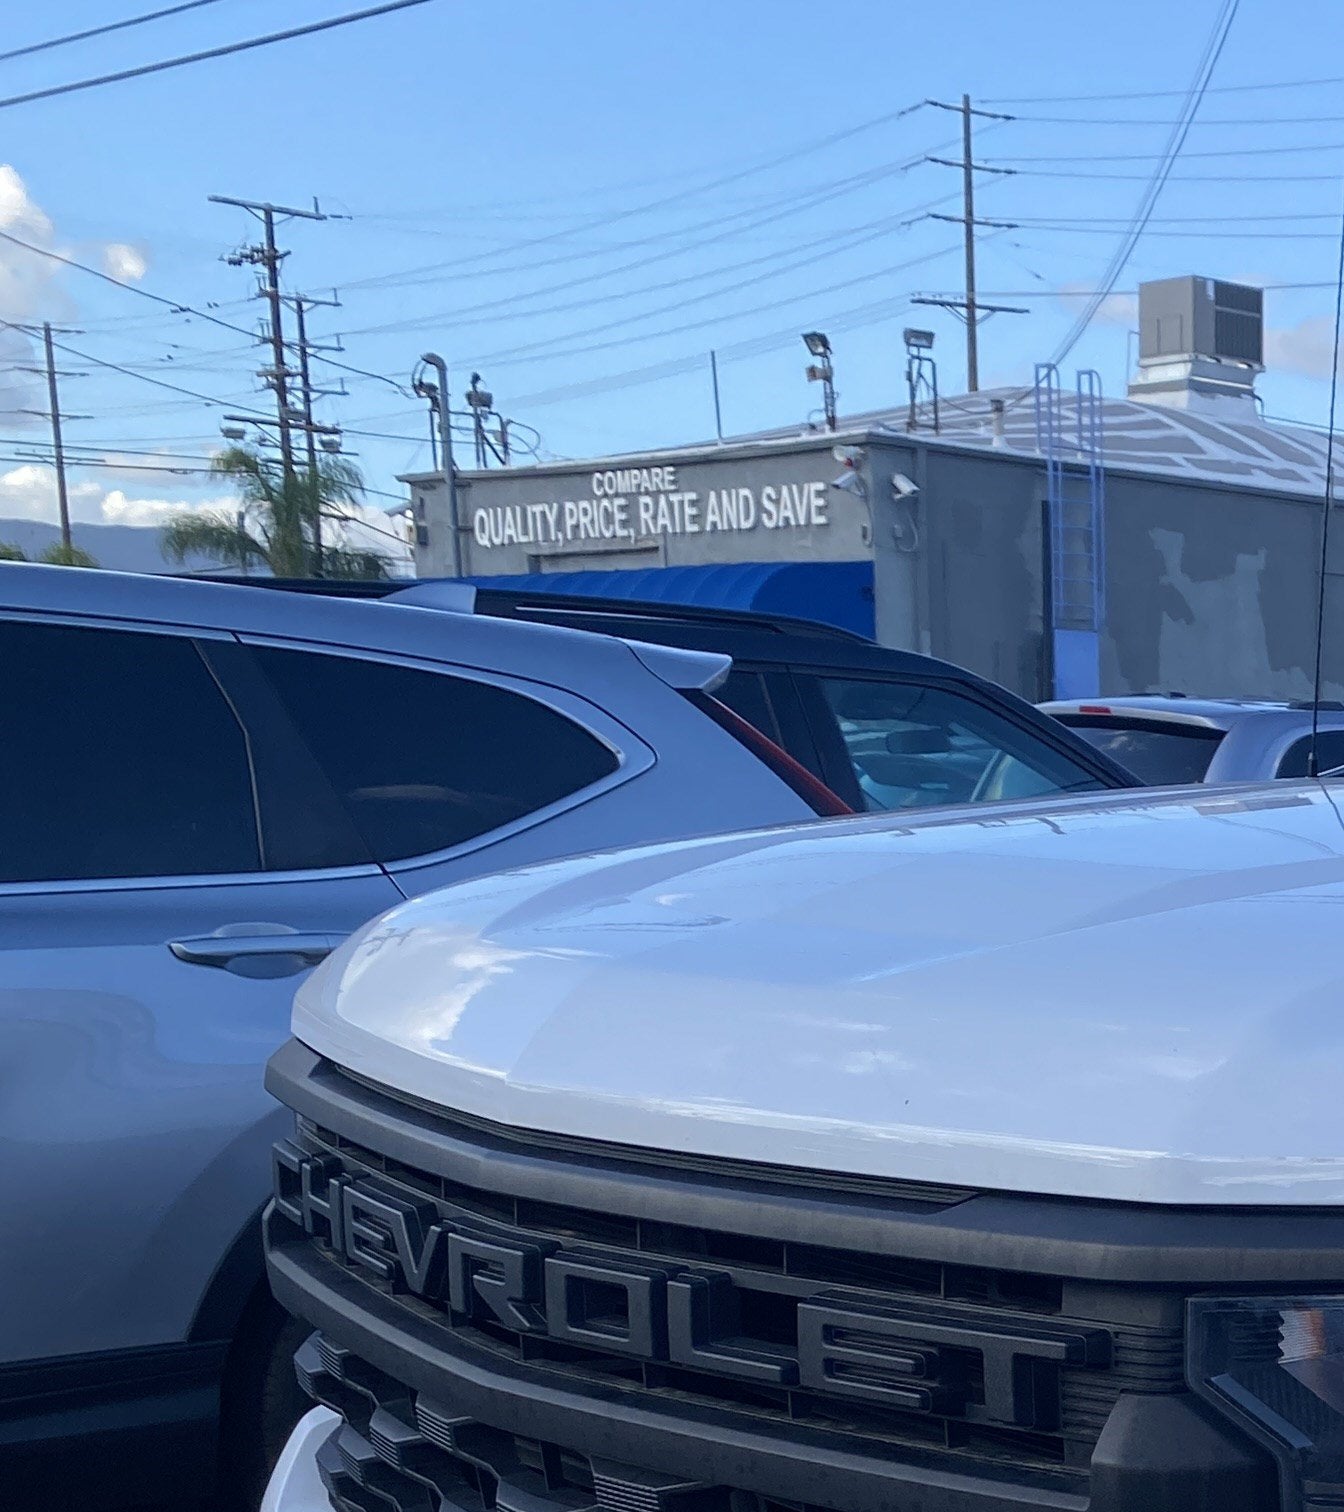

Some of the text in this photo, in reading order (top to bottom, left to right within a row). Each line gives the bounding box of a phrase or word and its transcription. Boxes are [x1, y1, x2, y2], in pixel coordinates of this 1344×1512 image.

[474, 481, 829, 548] QUALITY, PRICE, RATE AND SAVE
[592, 466, 678, 496] COMPARE
[271, 1138, 1105, 1431] CHEVROLET
